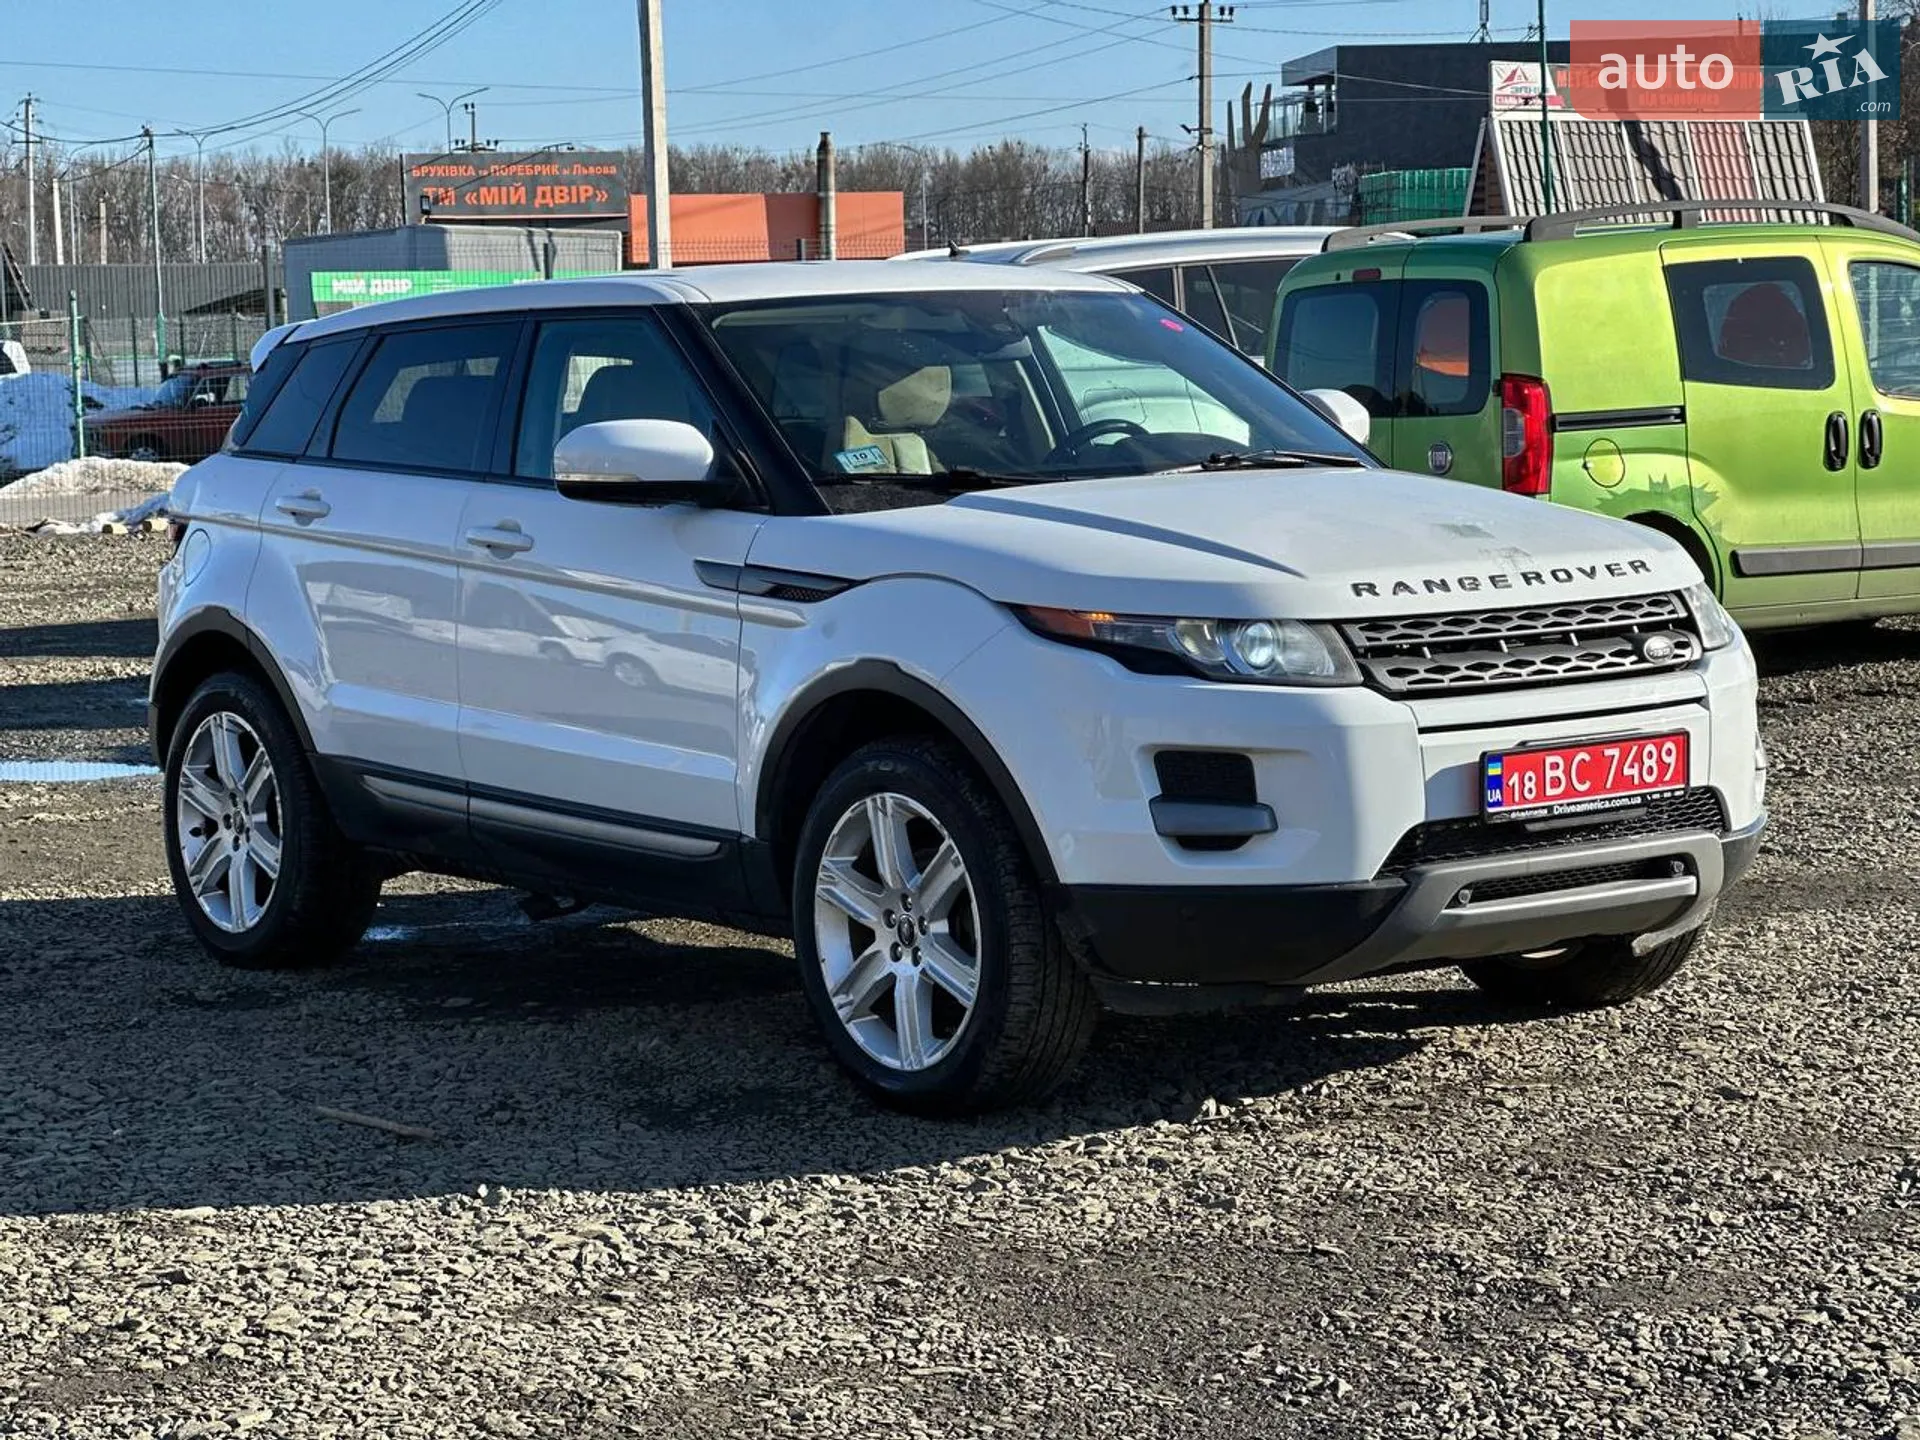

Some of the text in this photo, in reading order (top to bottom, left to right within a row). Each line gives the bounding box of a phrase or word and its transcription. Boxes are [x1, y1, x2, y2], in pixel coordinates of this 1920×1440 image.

[1350, 558, 1653, 598] RANGE ROVER
[1507, 740, 1678, 803] 18 BC 7489
[1487, 788, 1502, 803] UA
[1552, 796, 1642, 815] Driveamerica.com.ua
